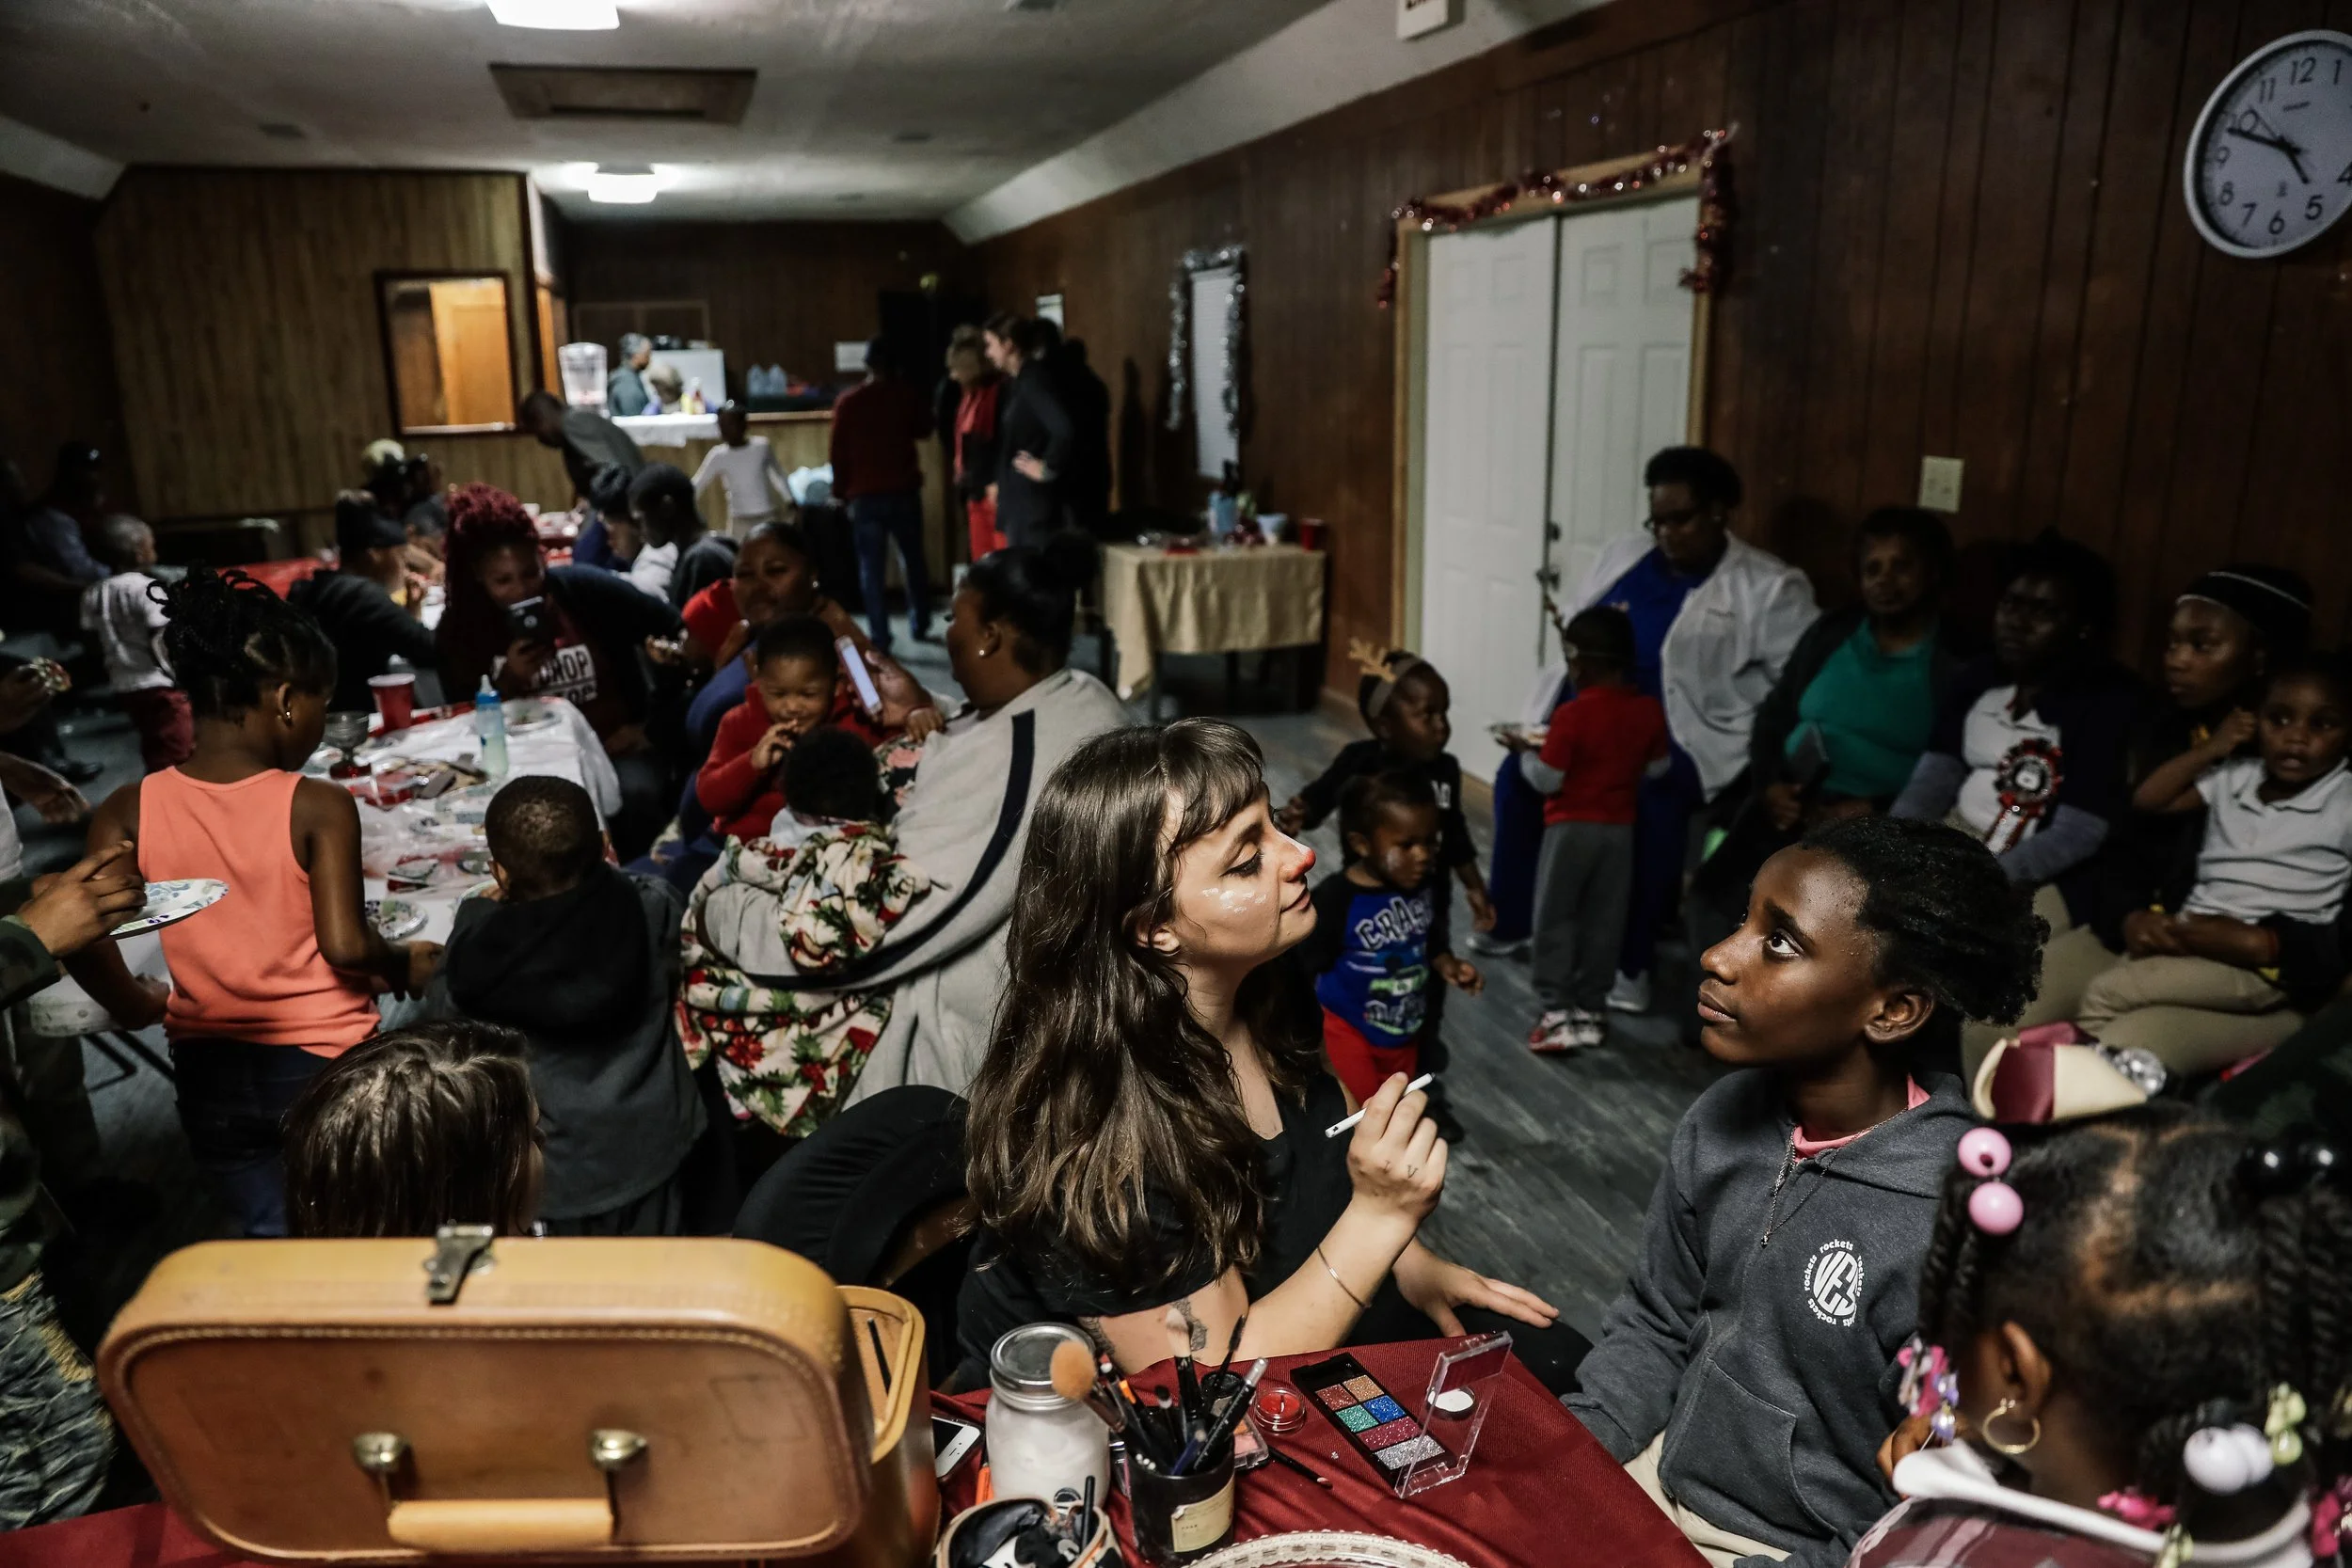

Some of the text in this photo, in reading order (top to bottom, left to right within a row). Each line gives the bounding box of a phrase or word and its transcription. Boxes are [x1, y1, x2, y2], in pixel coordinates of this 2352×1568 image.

[2290, 56, 2317, 86] 12
[2332, 58, 2343, 86] 1
[2260, 77, 2277, 103] 11
[2216, 146, 2231, 167] 9
[2217, 181, 2234, 207] 8
[2305, 194, 2324, 221] 5
[2243, 202, 2257, 228] 7
[2268, 208, 2285, 235] 6
[1819, 1239, 1854, 1254] rockets
[1804, 1254, 1818, 1291] rockets
[1807, 1298, 1837, 1325] rockets
